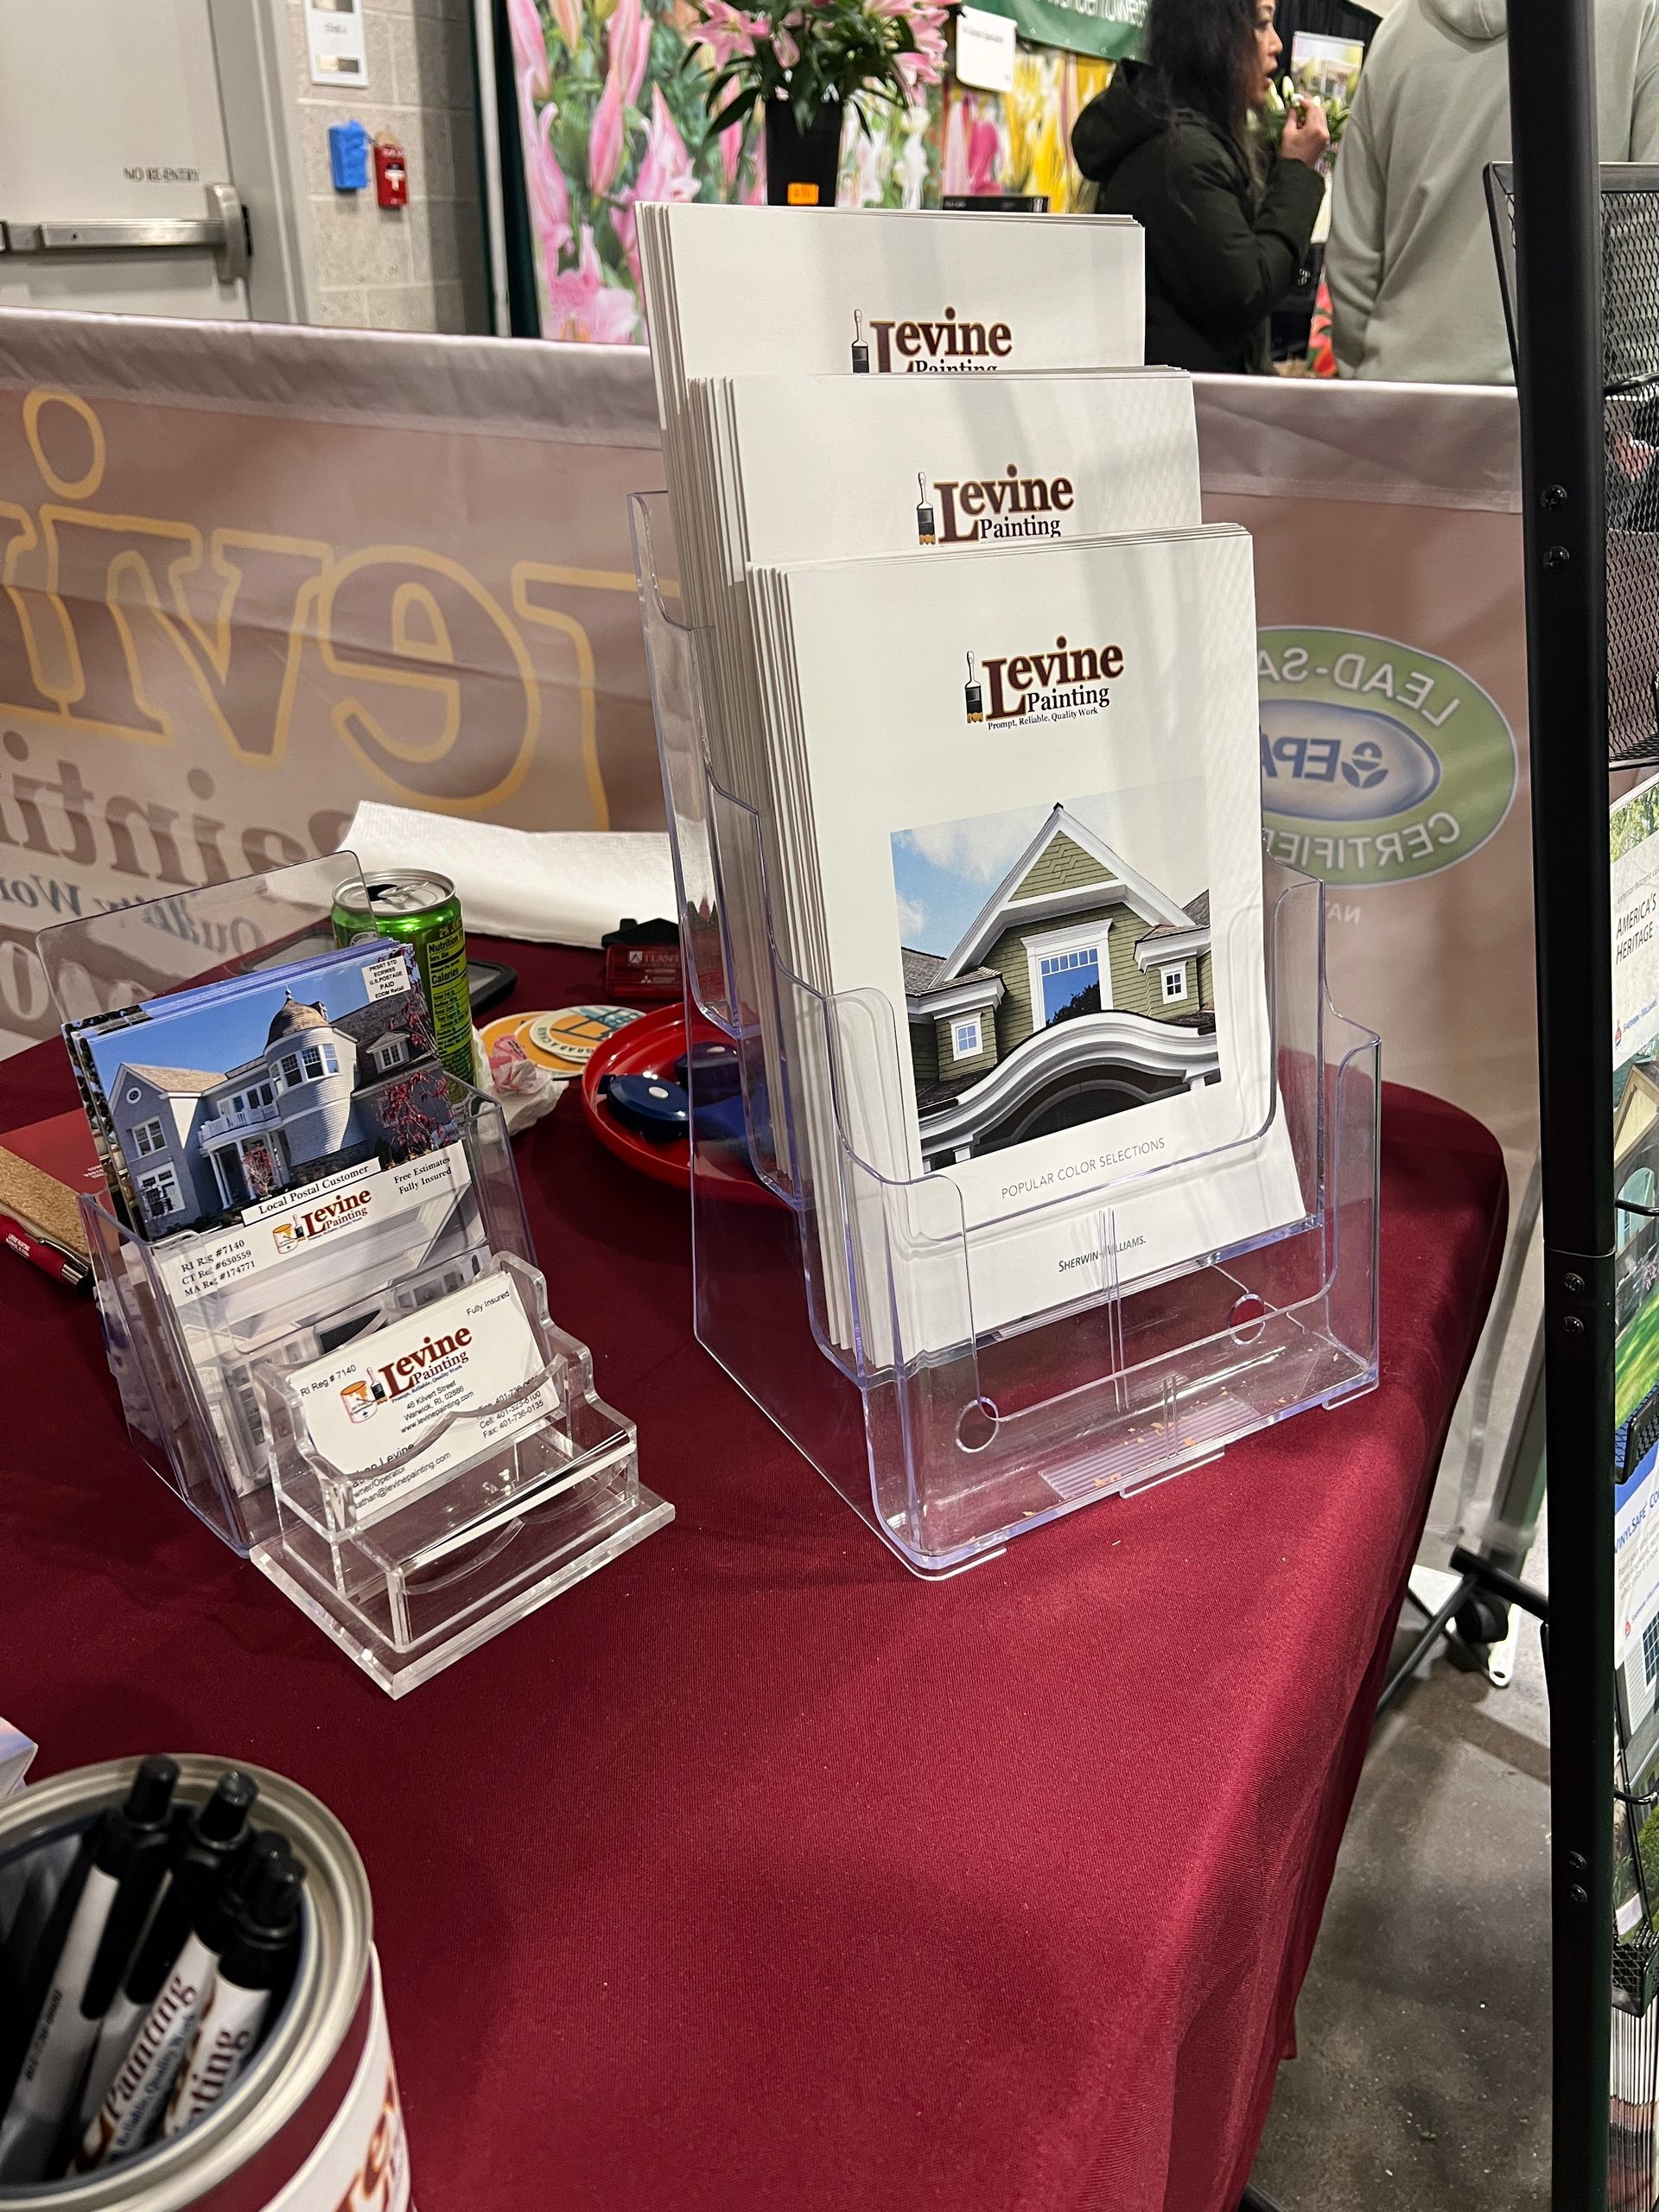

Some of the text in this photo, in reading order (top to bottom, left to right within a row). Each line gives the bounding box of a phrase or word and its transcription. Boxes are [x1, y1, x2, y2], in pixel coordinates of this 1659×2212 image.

[869, 306, 1013, 372] Levine
[933, 463, 1075, 543] Levine
[979, 514, 1061, 539] Painting
[982, 635, 1124, 721] Levine
[1027, 684, 1110, 713] Painting
[988, 706, 1098, 730] Prompt, Reliable, Quality Work
[1616, 893, 1657, 940] AMERICA'S
[429, 933, 458, 954] Nutrition
[1616, 921, 1654, 965] HERITAGE
[380, 981, 395, 989] PAID
[431, 967, 459, 985] Calories
[394, 1156, 450, 1185] Free Estimates
[398, 1166, 452, 1196] Fully Insured
[1001, 1137, 1166, 1199] POPULAR COLOR SELECTIONS
[258, 1166, 369, 1215] Local Postal Customer
[301, 1187, 372, 1238] Levine
[326, 1207, 368, 1229] Painting
[181, 1262, 194, 1273] RI
[215, 1239, 245, 1257] #7140
[181, 1274, 196, 1285] CT
[215, 1249, 251, 1270] #630559
[184, 1285, 200, 1297] MA
[219, 1260, 256, 1280] #174771
[467, 1289, 510, 1316] Fully Insured
[378, 1327, 473, 1399] Levine
[413, 1351, 469, 1384] Painting
[300, 1386, 310, 1396] RI
[311, 1379, 329, 1391] Reg
[335, 1364, 357, 1379] 7140
[436, 1380, 456, 1394] Street
[401, 1391, 474, 1433] www.levinepainting.com
[404, 1404, 434, 1421] Warwick,
[499, 1400, 544, 1428] 401-736-0135
[353, 1465, 406, 1498] wner/Operator
[102, 1975, 197, 2122] Painting
